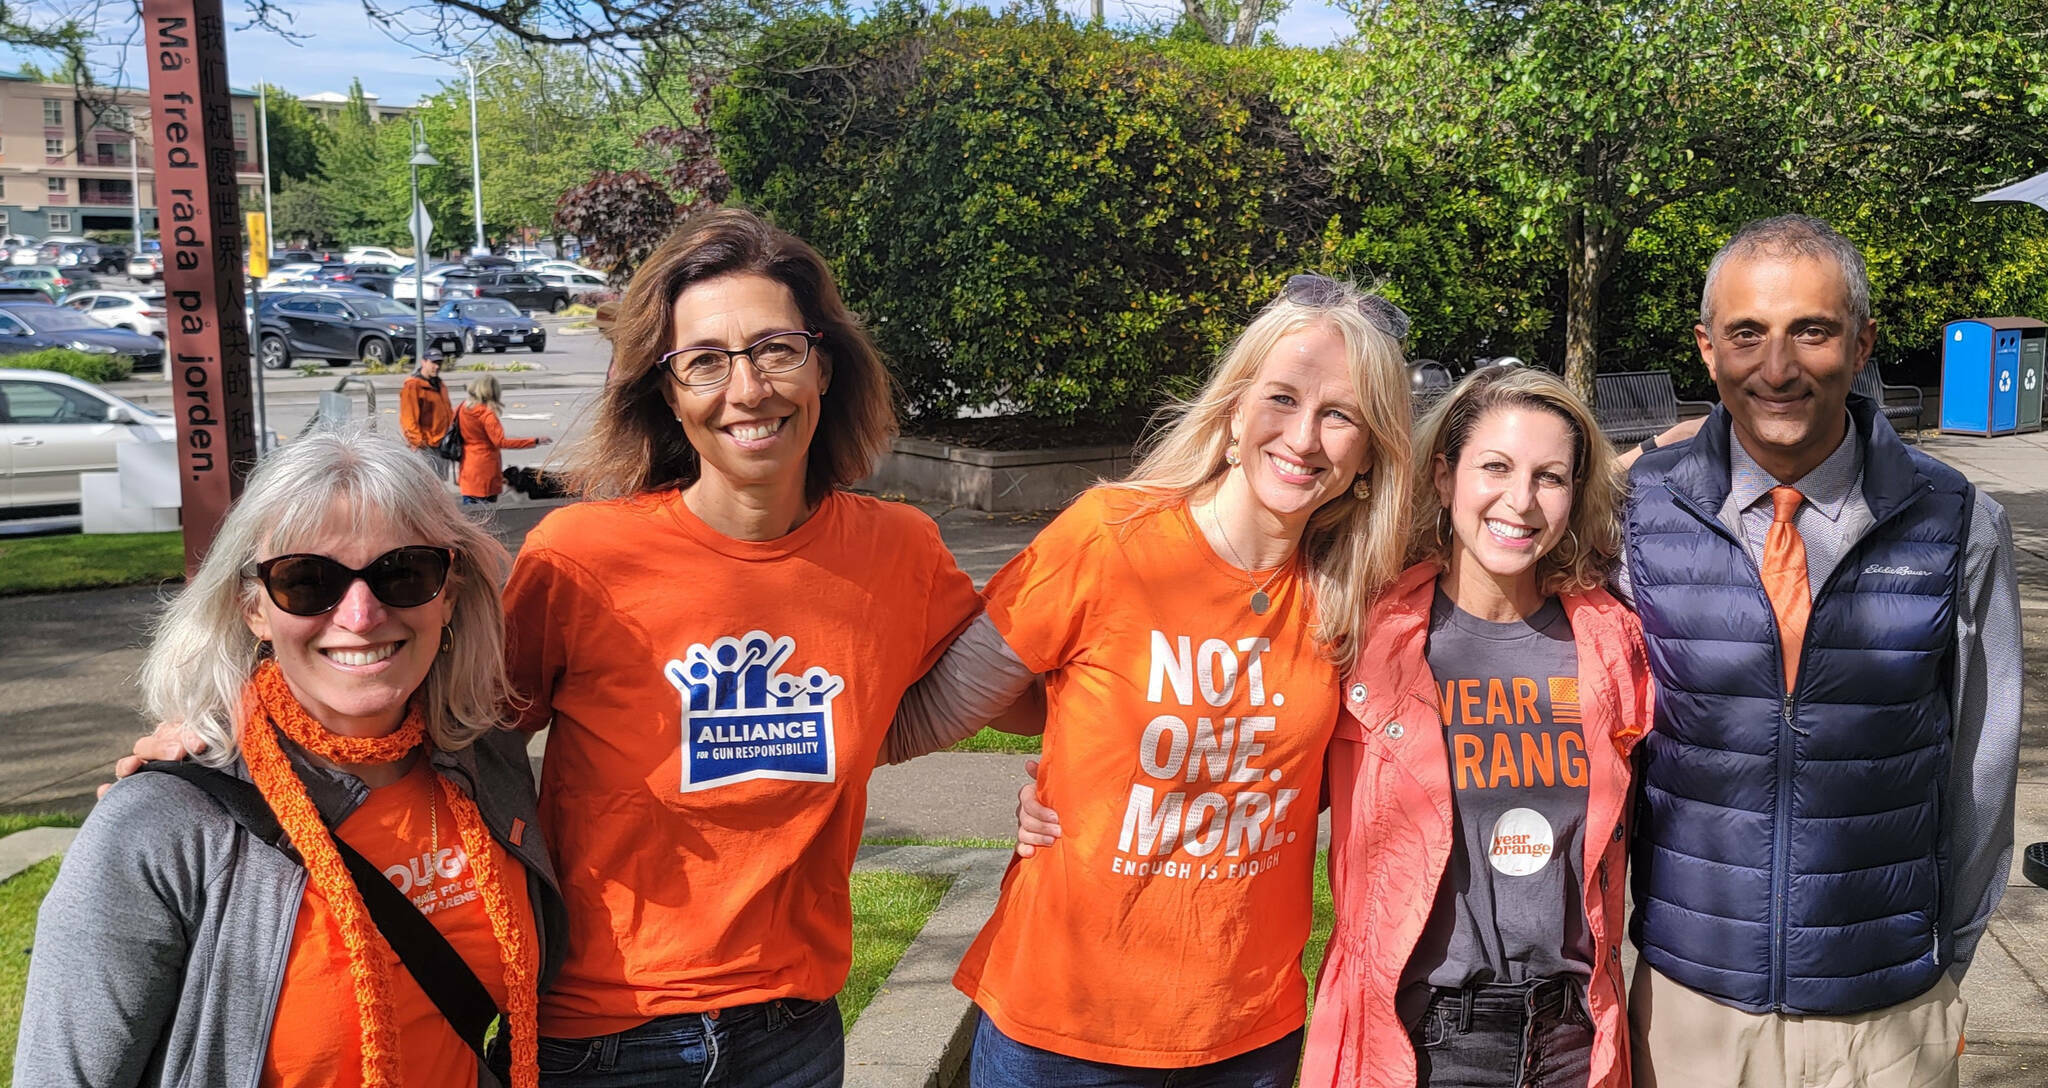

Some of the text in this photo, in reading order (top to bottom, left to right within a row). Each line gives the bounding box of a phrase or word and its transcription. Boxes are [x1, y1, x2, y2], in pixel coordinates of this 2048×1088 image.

[158, 17, 218, 482] Må fred råda på jorden.
[1147, 630, 1285, 707] NOT.
[696, 741, 819, 760] FOR GUN RESPONSIBILITY
[697, 720, 818, 744] ALLIANCE
[1139, 715, 1283, 783] ONE.
[1117, 783, 1301, 857] MORE.
[1111, 851, 1280, 880] ENOUGH IS ENOUGH
[1493, 842, 1551, 858] orange
